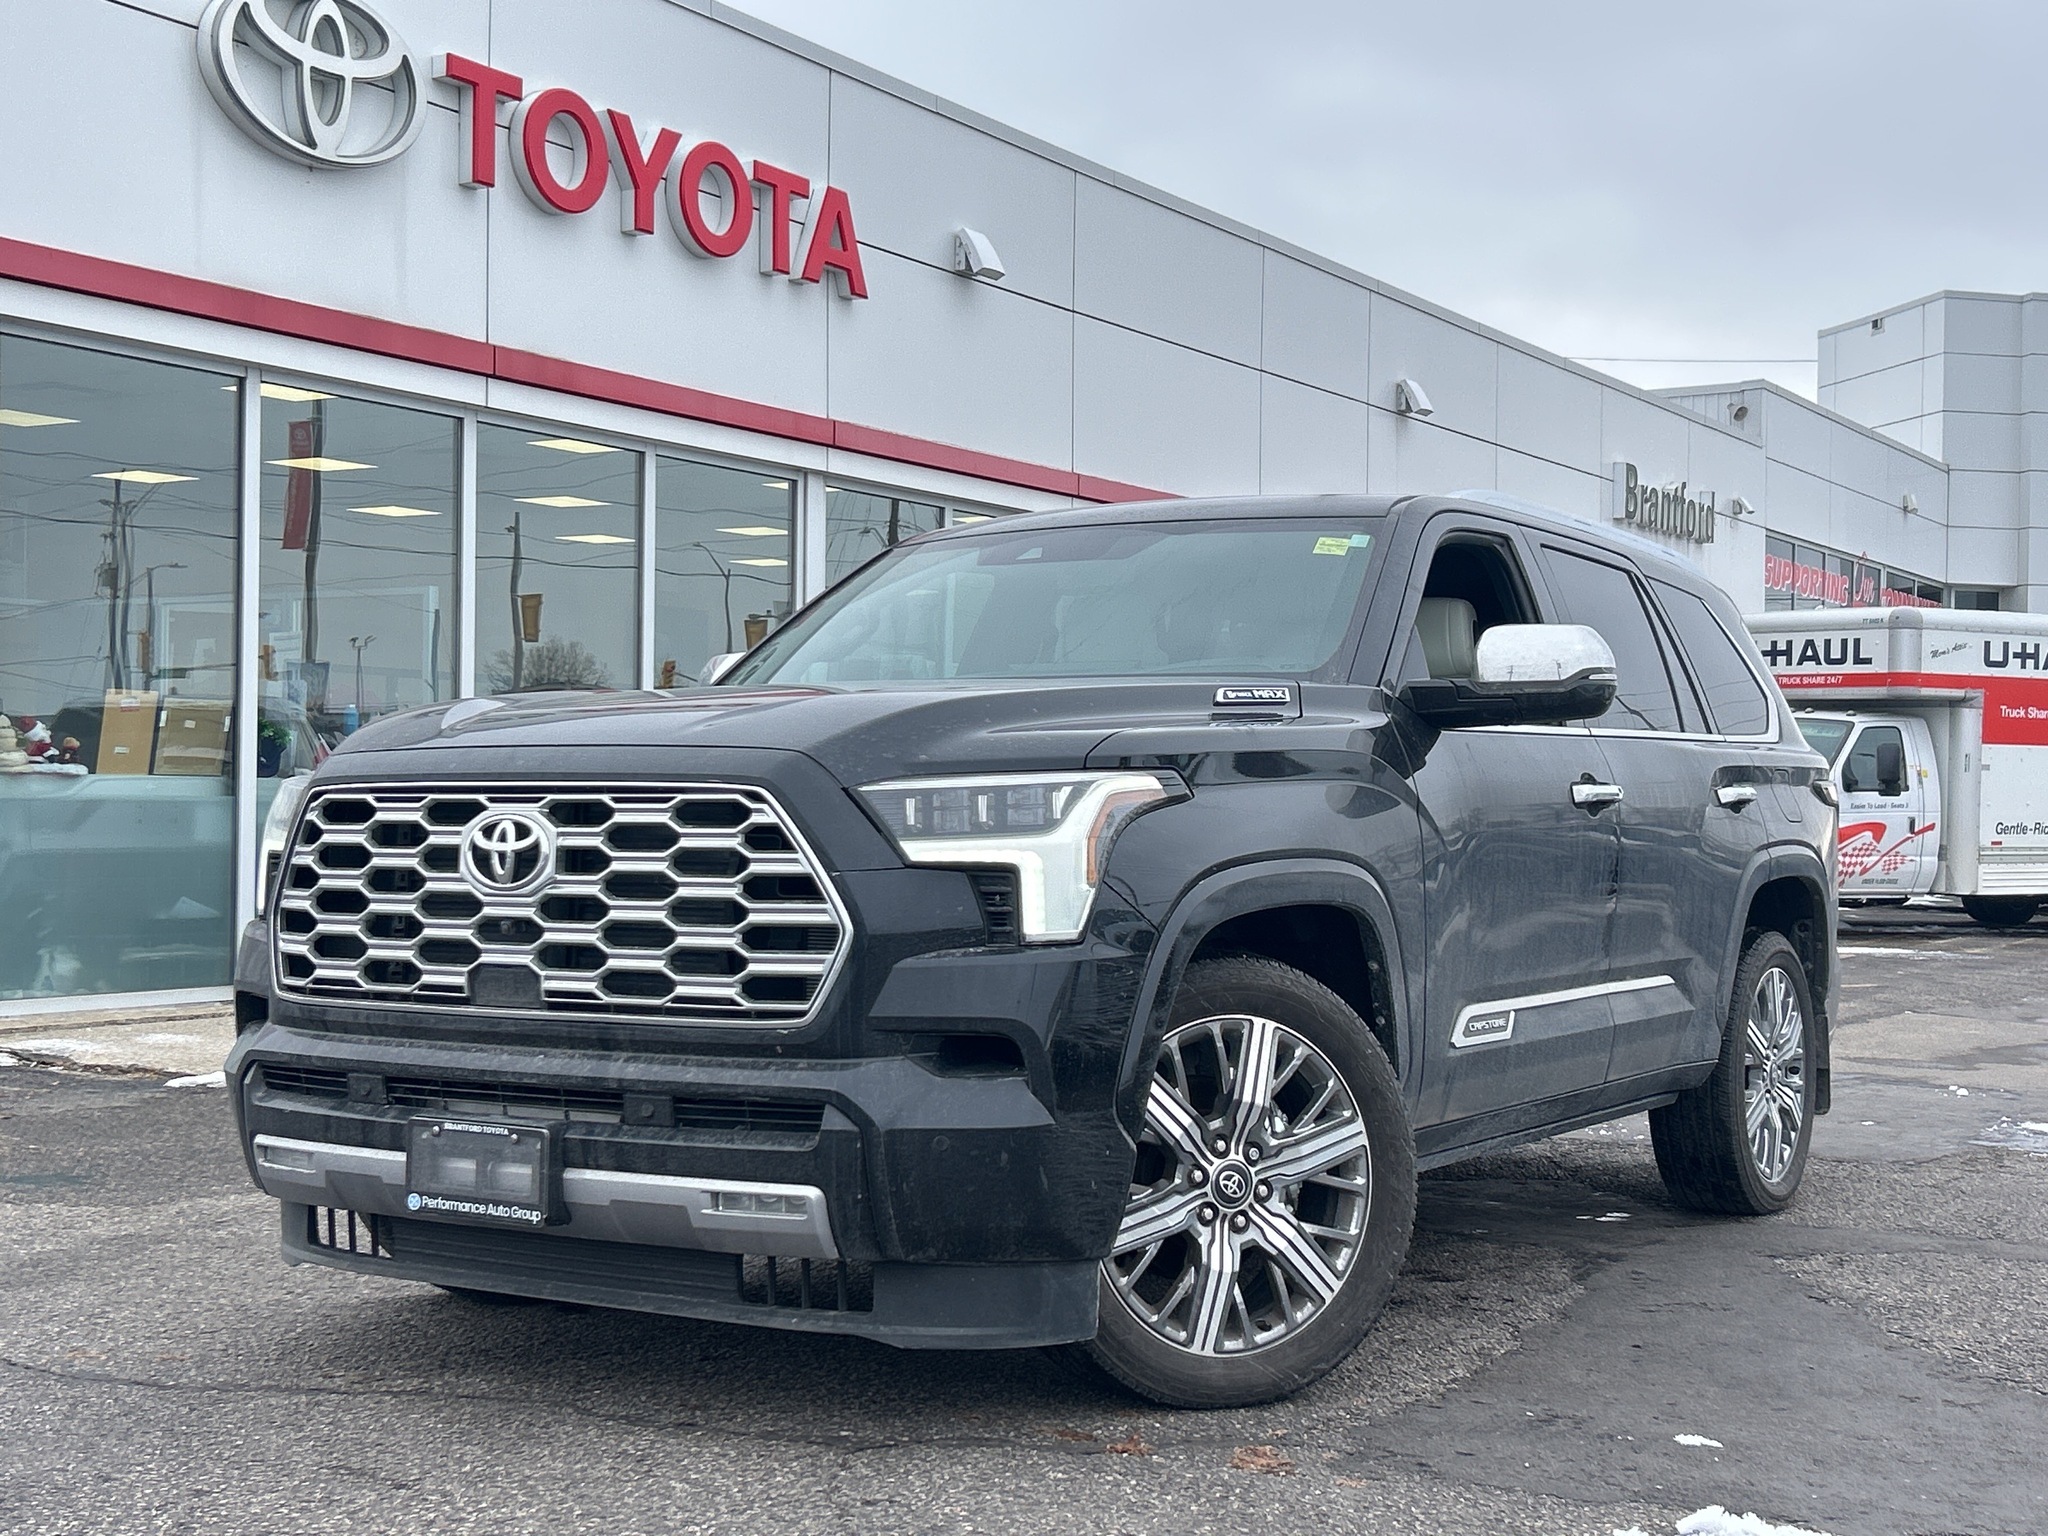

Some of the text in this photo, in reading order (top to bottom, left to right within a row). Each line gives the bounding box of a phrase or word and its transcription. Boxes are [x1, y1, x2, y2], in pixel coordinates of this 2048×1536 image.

[444, 52, 868, 300] TOYOTA
[1624, 462, 1715, 544] Brantford
[1765, 553, 1849, 606] SUPPORTING
[1755, 637, 1873, 667] -HAUL
[1984, 640, 2048, 671] U-H
[1778, 675, 1843, 685] TRUCK SHARE 24/7
[2000, 705, 2026, 718] Truck
[1468, 1018, 1507, 1031] CAPSTONE
[444, 1122, 509, 1135] BRANTFORD TOYOTA
[422, 1195, 541, 1224] Performance Auto Group
